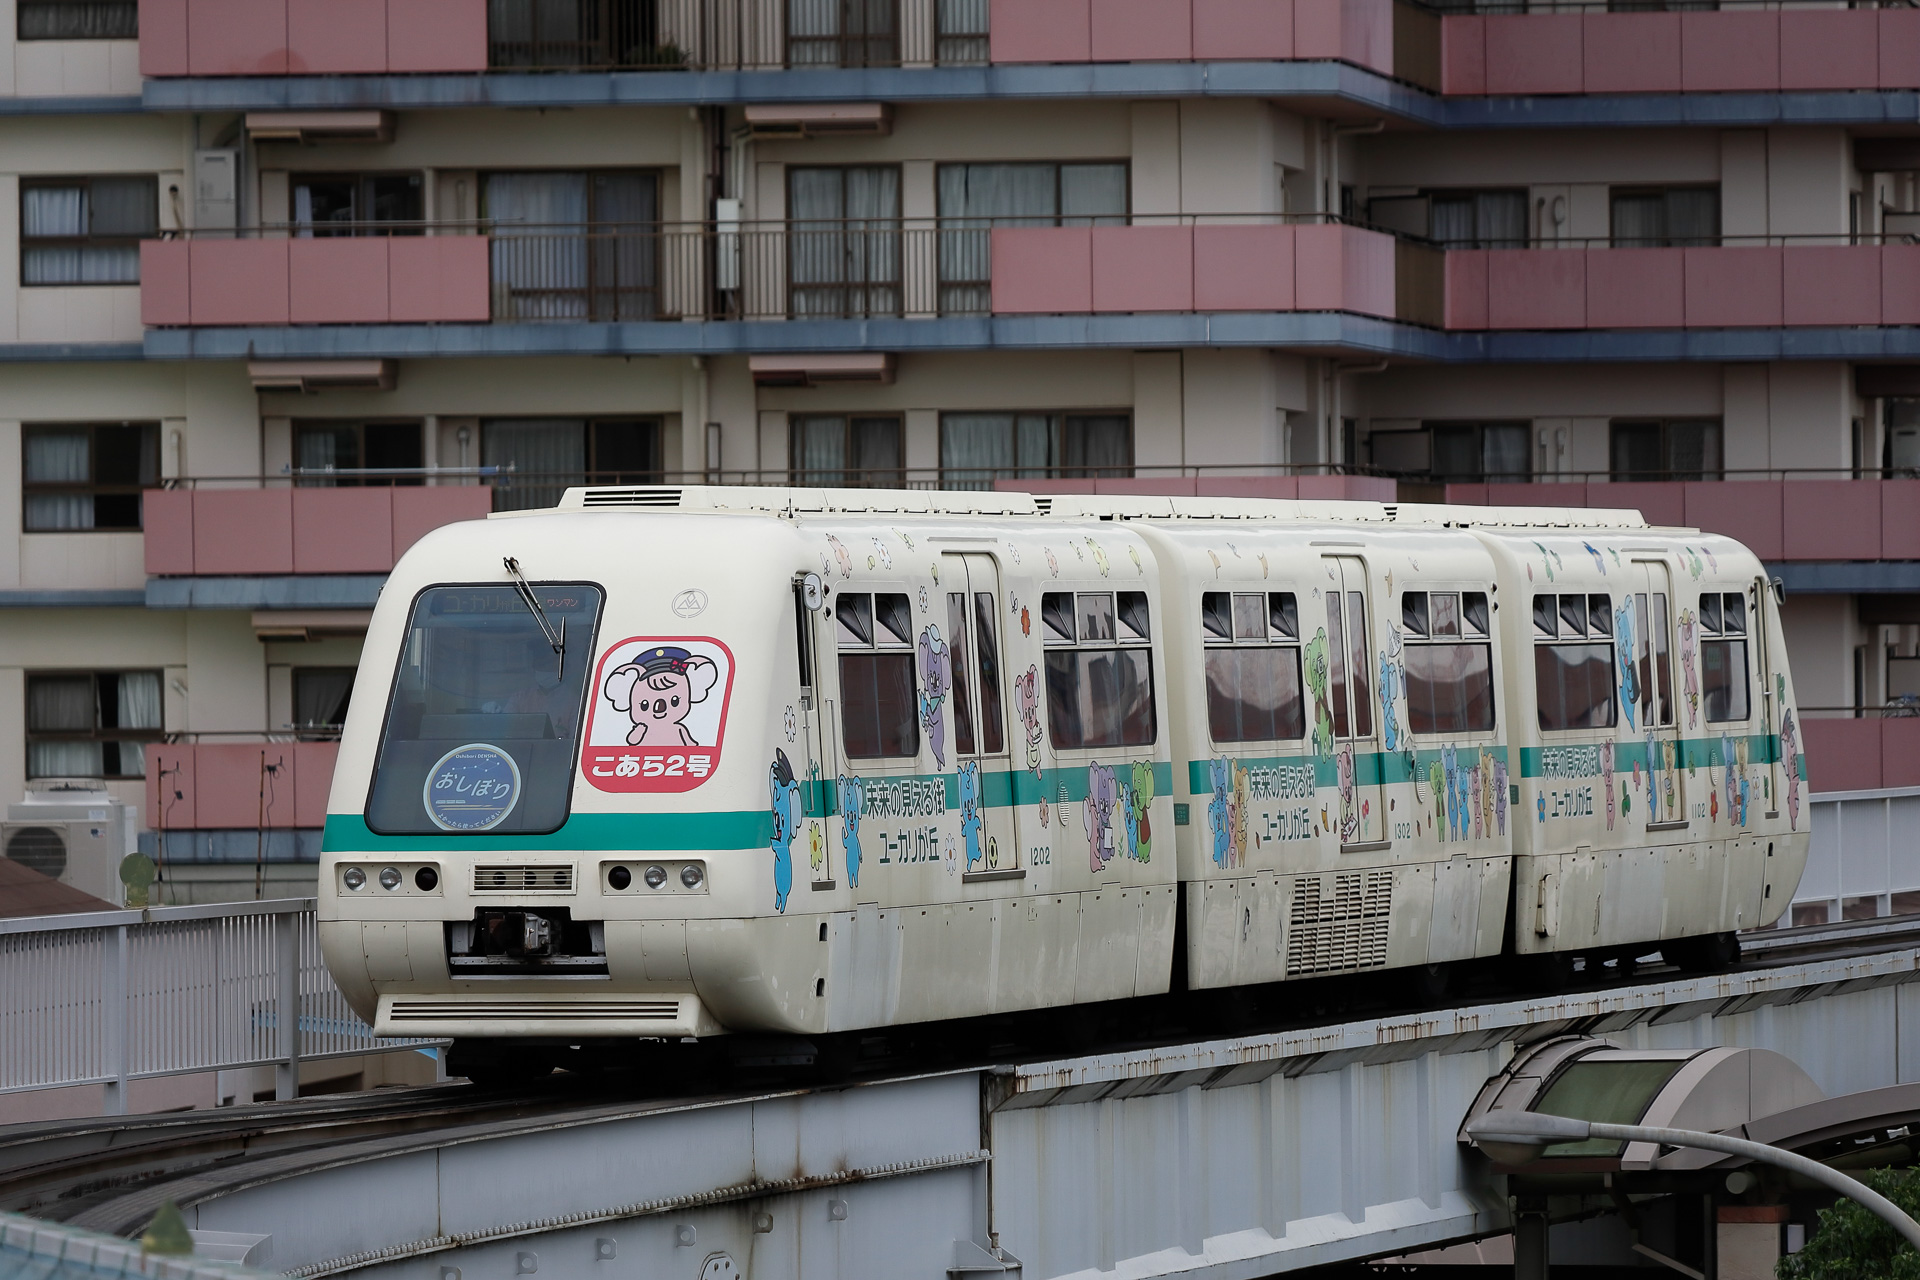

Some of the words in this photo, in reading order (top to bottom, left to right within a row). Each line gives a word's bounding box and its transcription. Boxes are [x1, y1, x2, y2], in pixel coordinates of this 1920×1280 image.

[443, 595, 545, 612] ユーカリが丘
[547, 598, 578, 607] ワンマン
[592, 754, 712, 778] こあら2号
[1542, 746, 1597, 780] 未来の見える街
[435, 772, 511, 800] おしぼり
[1250, 763, 1316, 801] 未来の見える街
[866, 777, 946, 820] 未来の見える街
[1551, 786, 1593, 818] ユーカリが丘
[1691, 802, 1706, 819] 1102
[1262, 807, 1312, 842] ユーカリが丘
[1394, 822, 1411, 840] 1302
[879, 825, 941, 865] ユーカリが丘
[1030, 846, 1051, 866] 1202
